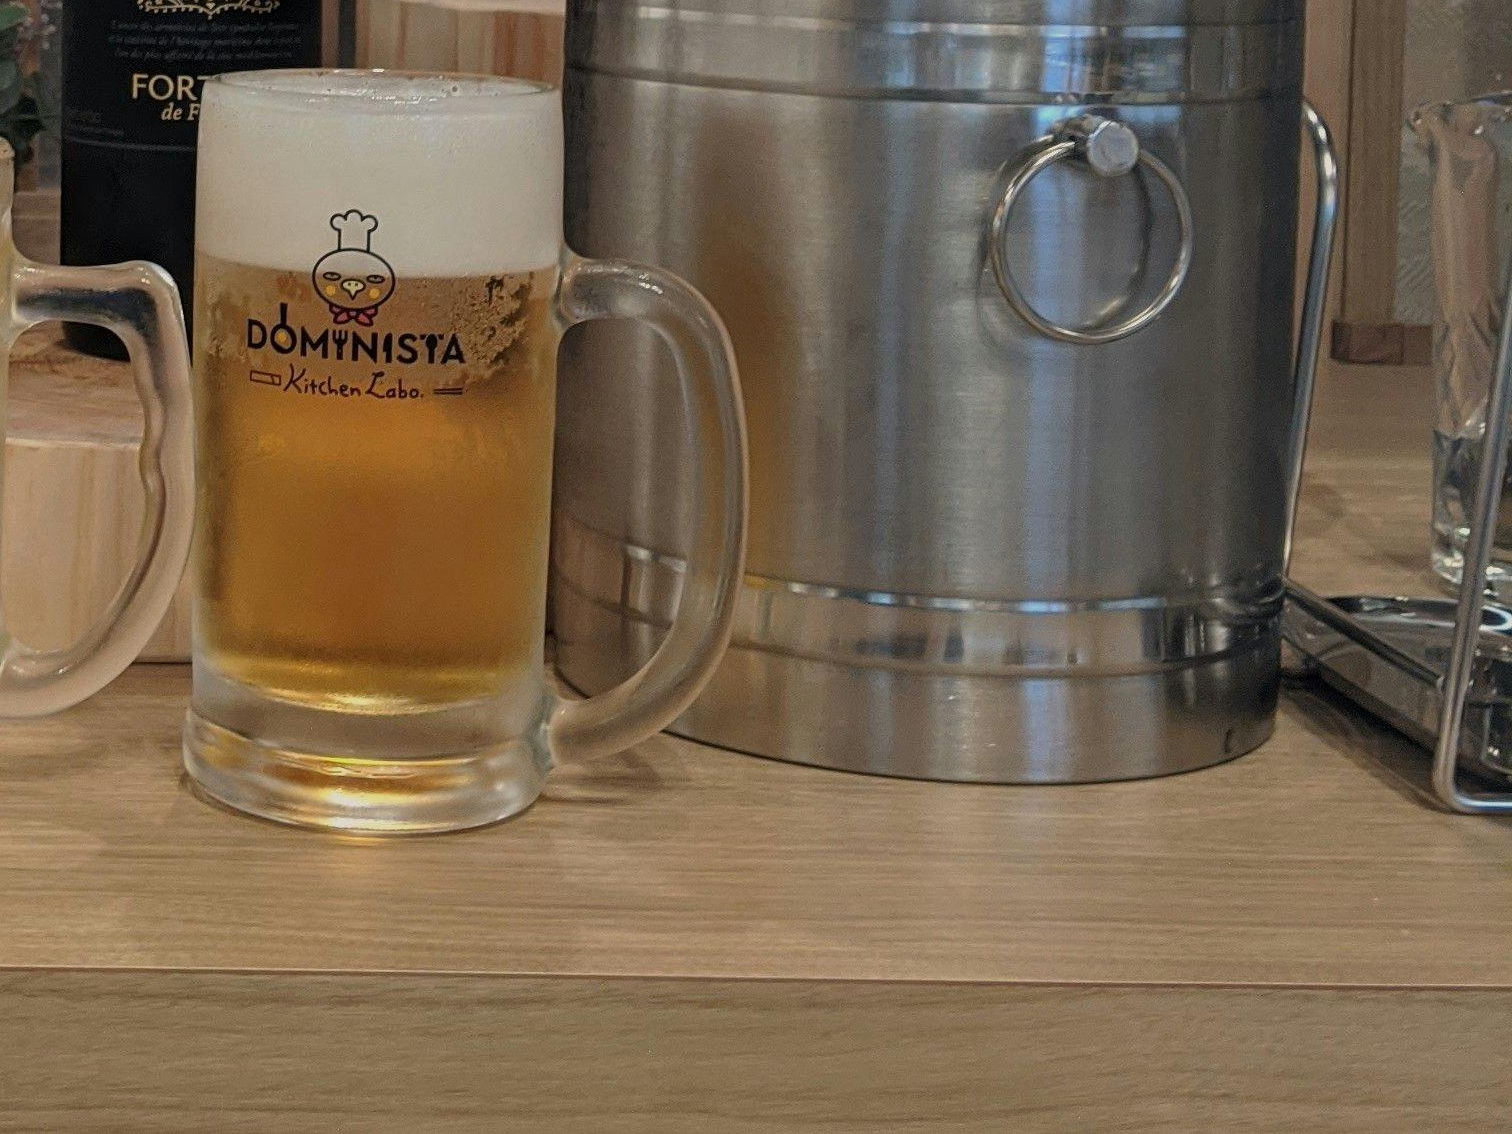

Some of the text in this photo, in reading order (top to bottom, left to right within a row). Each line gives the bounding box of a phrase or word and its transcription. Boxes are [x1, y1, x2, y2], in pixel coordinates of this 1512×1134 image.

[161, 101, 183, 120] de
[247, 309, 466, 364] DOMINISTA
[284, 363, 424, 399] Kitchen Labo.
